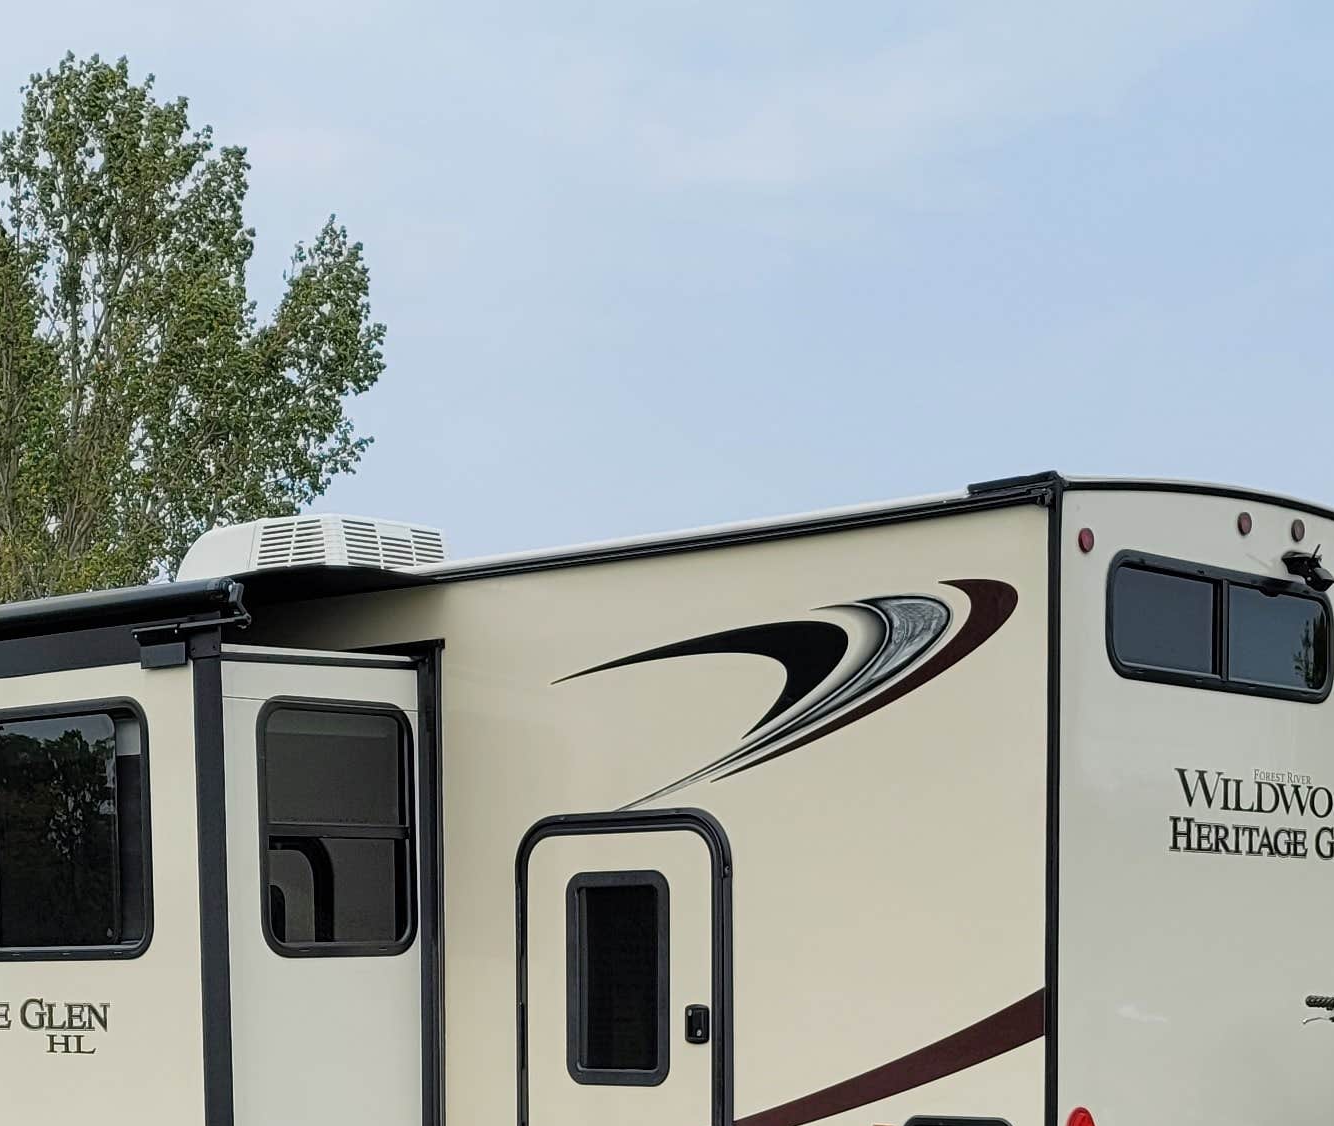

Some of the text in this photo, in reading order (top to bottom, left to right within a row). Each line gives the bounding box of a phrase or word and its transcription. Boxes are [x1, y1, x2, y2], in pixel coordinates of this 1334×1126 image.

[1254, 768, 1312, 785] FOREST RIVER
[1169, 815, 1308, 859] HERITAGE
[20, 997, 110, 1032] GLEN
[46, 1034, 96, 1054] HL
